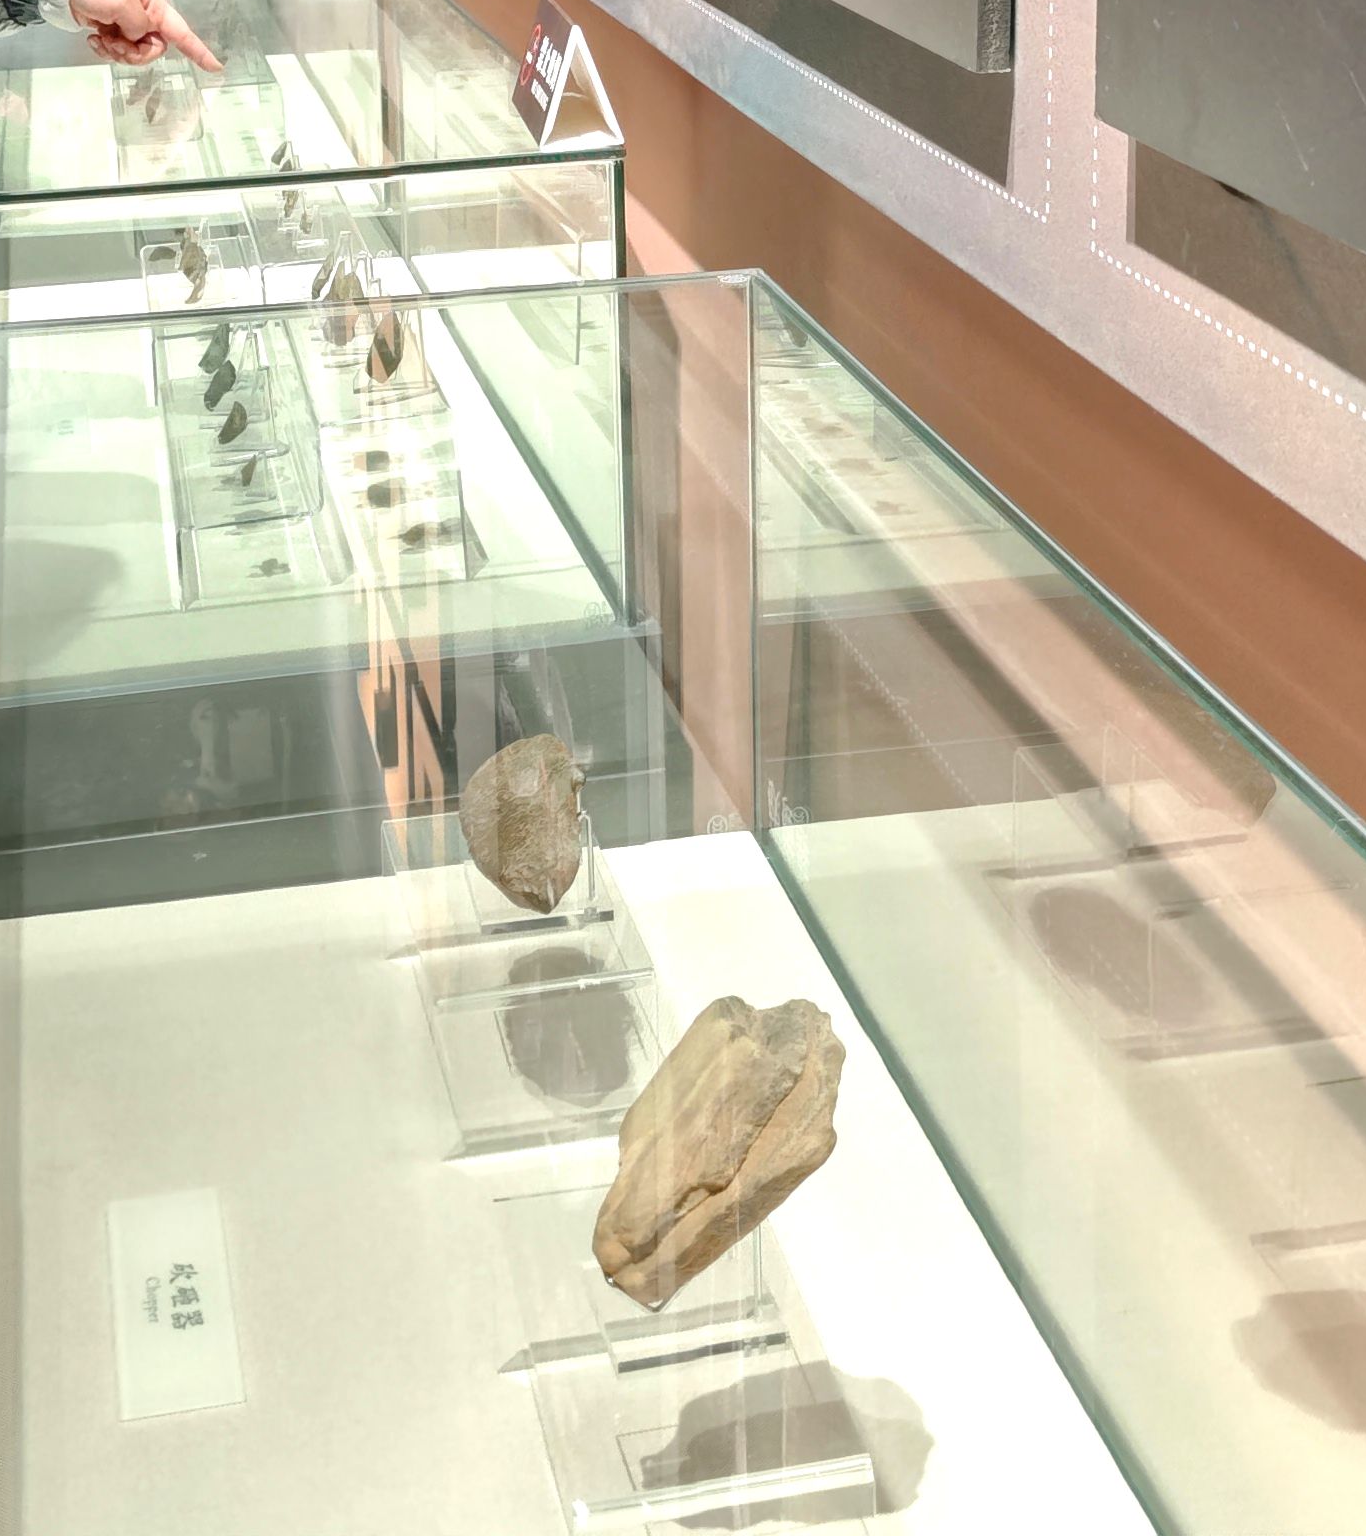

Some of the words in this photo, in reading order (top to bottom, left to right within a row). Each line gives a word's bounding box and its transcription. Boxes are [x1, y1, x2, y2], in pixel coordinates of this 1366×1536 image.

[142, 1277, 161, 1323] Chopper
[169, 1263, 205, 1330] 砍砸器
